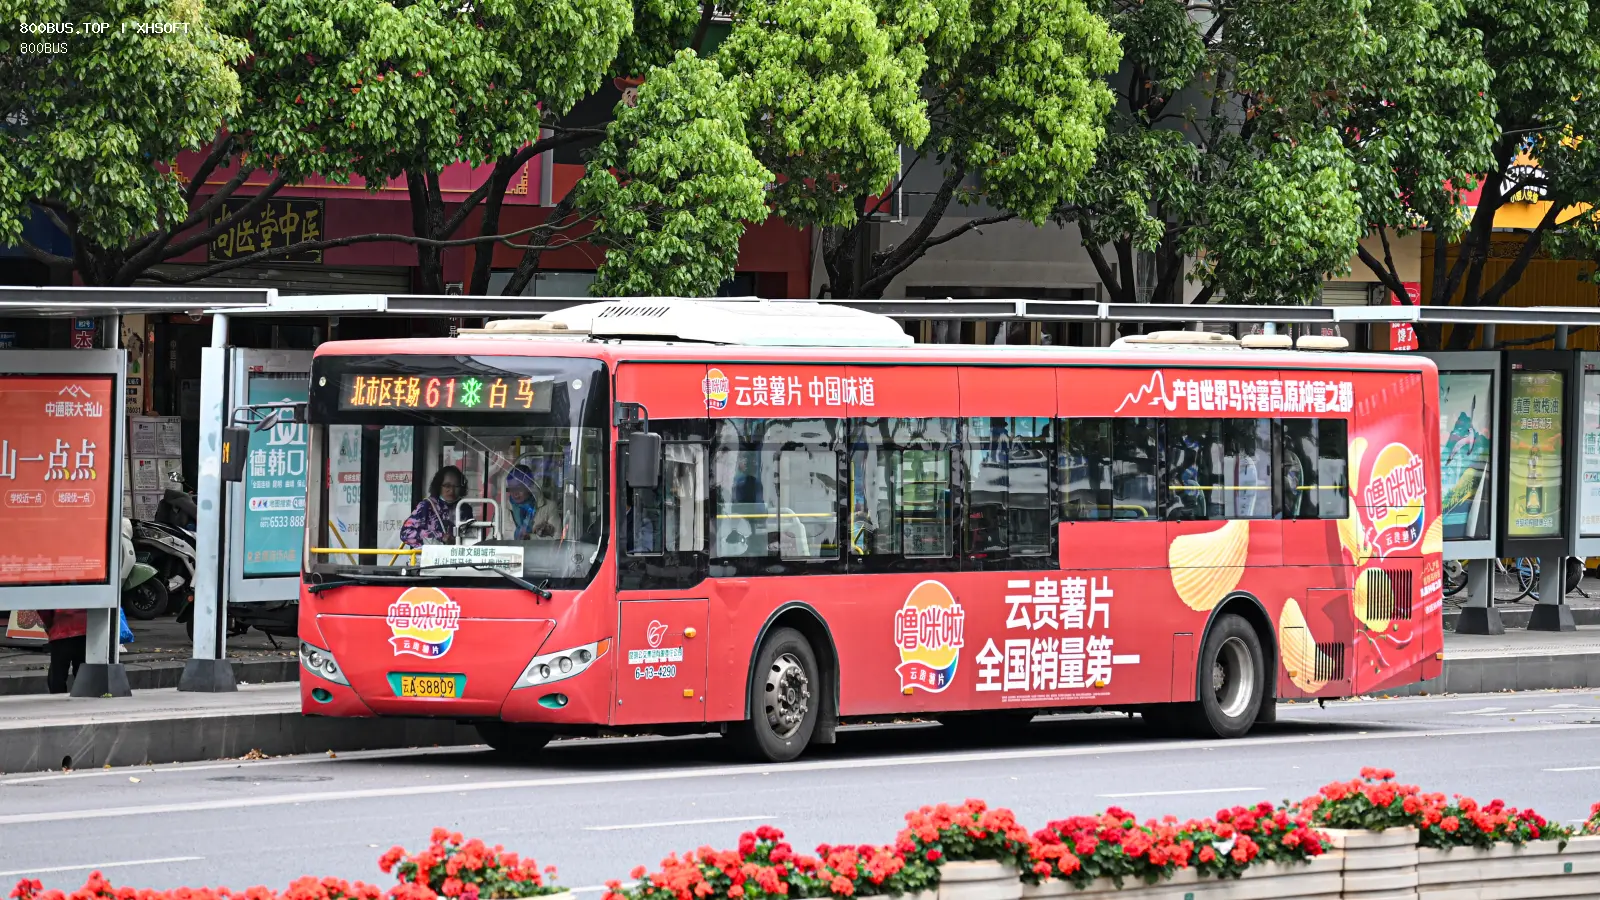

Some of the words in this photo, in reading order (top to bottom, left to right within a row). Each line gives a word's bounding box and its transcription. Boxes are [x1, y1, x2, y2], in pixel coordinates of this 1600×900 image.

[351, 377, 420, 406] 北市区车场
[426, 378, 455, 407] 61
[734, 375, 802, 406] 云贵薯片
[808, 375, 875, 406] 中国味道
[1168, 379, 1353, 412] 产自世界马铃薯高原种薯之都
[45, 401, 102, 417] 中通联大书山
[387, 602, 460, 630] 噜咪啦
[1005, 576, 1113, 630] 云贵薯片
[895, 604, 964, 651] 噜咪啦
[635, 665, 676, 680] 6-13-4290
[976, 635, 1140, 692] 全国销量第一
